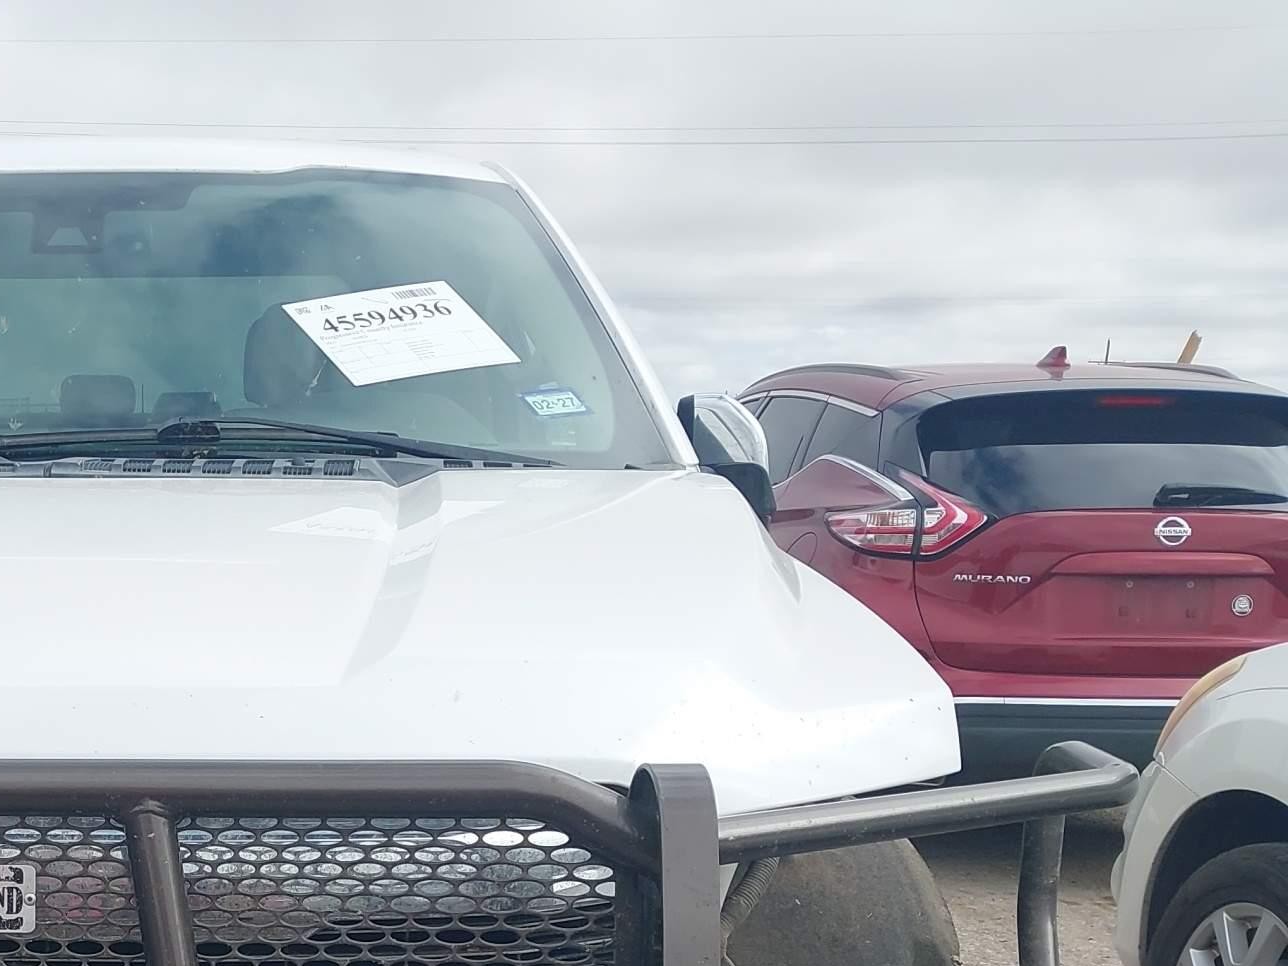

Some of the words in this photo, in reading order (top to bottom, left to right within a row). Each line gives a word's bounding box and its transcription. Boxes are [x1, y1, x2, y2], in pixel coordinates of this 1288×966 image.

[322, 300, 453, 333] 45594936
[1159, 528, 1189, 536] NISSAN
[952, 573, 1032, 585] MURANO
